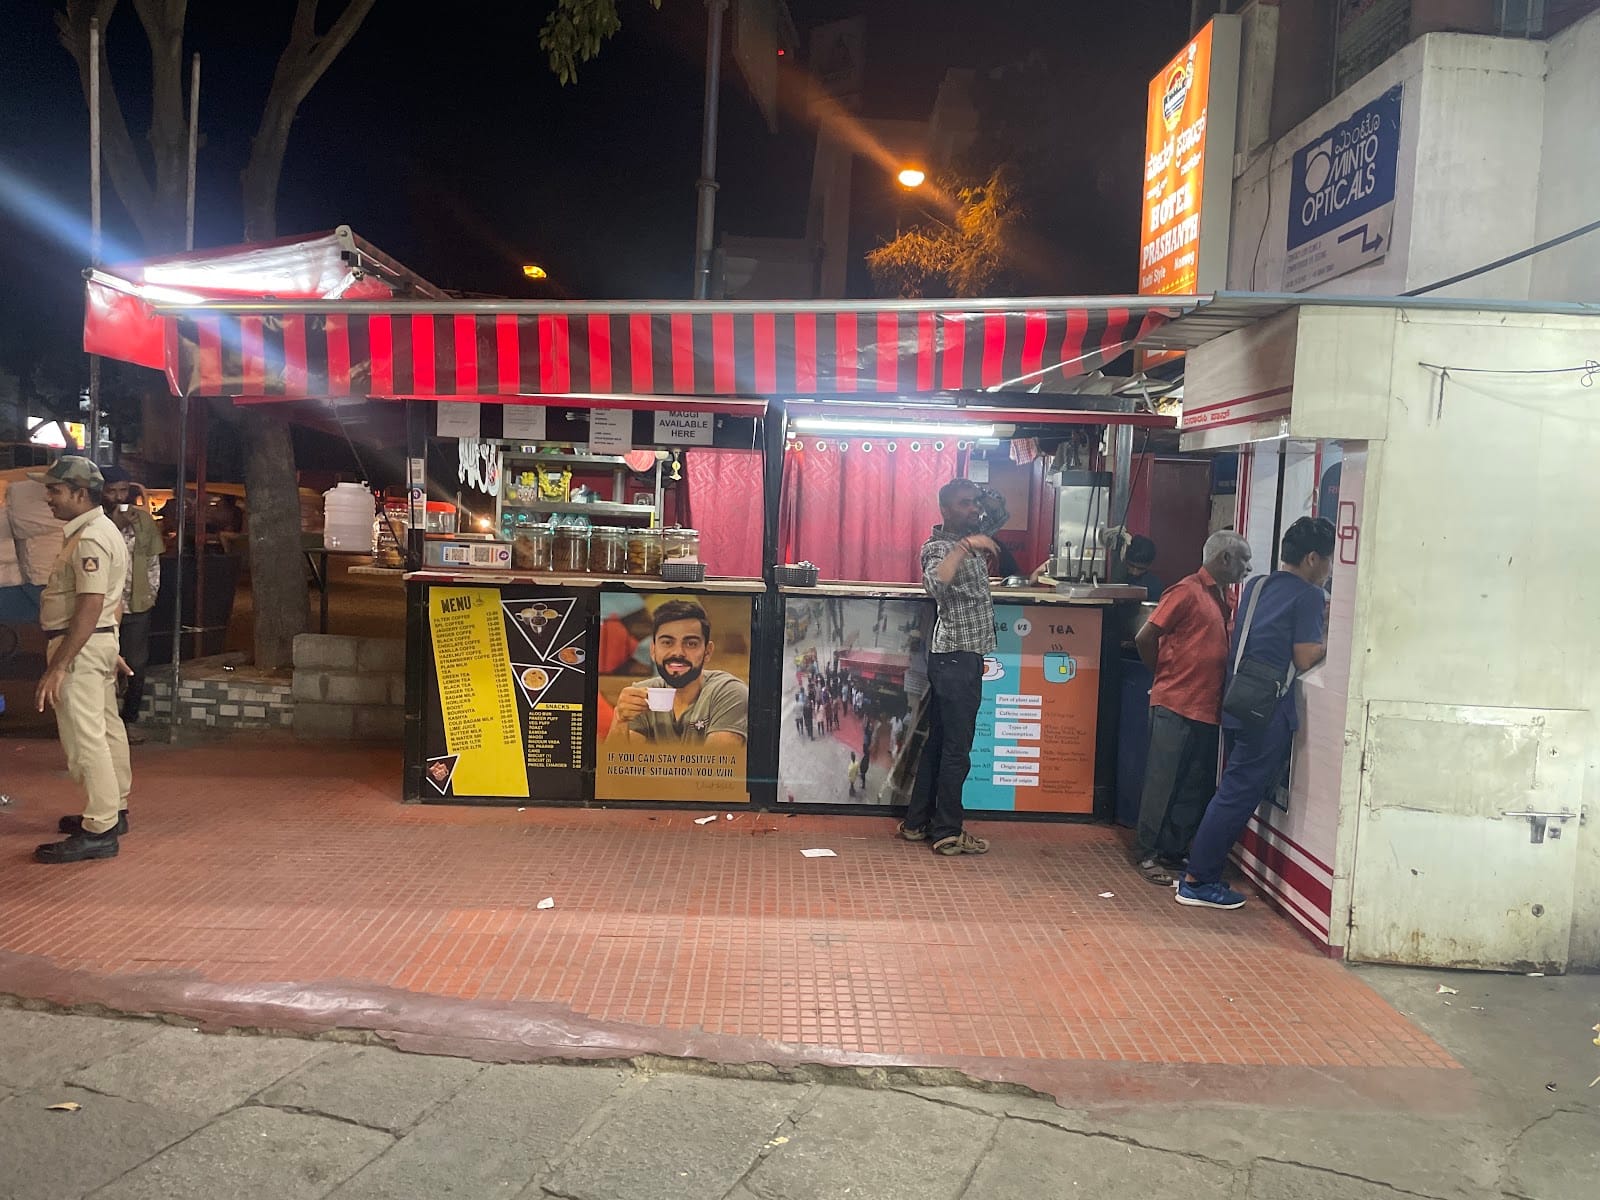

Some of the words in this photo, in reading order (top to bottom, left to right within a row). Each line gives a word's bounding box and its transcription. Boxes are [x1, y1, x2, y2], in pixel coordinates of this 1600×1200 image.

[1328, 134, 1378, 185] MINTO
[1302, 162, 1376, 226] OPTICALS
[1150, 182, 1192, 233] HOTEL
[1142, 212, 1199, 270] PRASHANTH
[659, 419, 708, 428] AVAILABLE
[671, 430, 696, 438] HERE
[441, 595, 471, 613] MENU
[608, 753, 615, 762] IF
[618, 753, 635, 762] YOU
[638, 754, 655, 763] CAN
[658, 754, 677, 763] STAY
[680, 755, 716, 764] POSITIVE
[719, 756, 728, 764] IN
[730, 756, 736, 764] A
[607, 766, 646, 776] NEGATIVE
[650, 767, 693, 777] SITUATION
[696, 768, 713, 777] YOU
[716, 768, 733, 777] WIN
